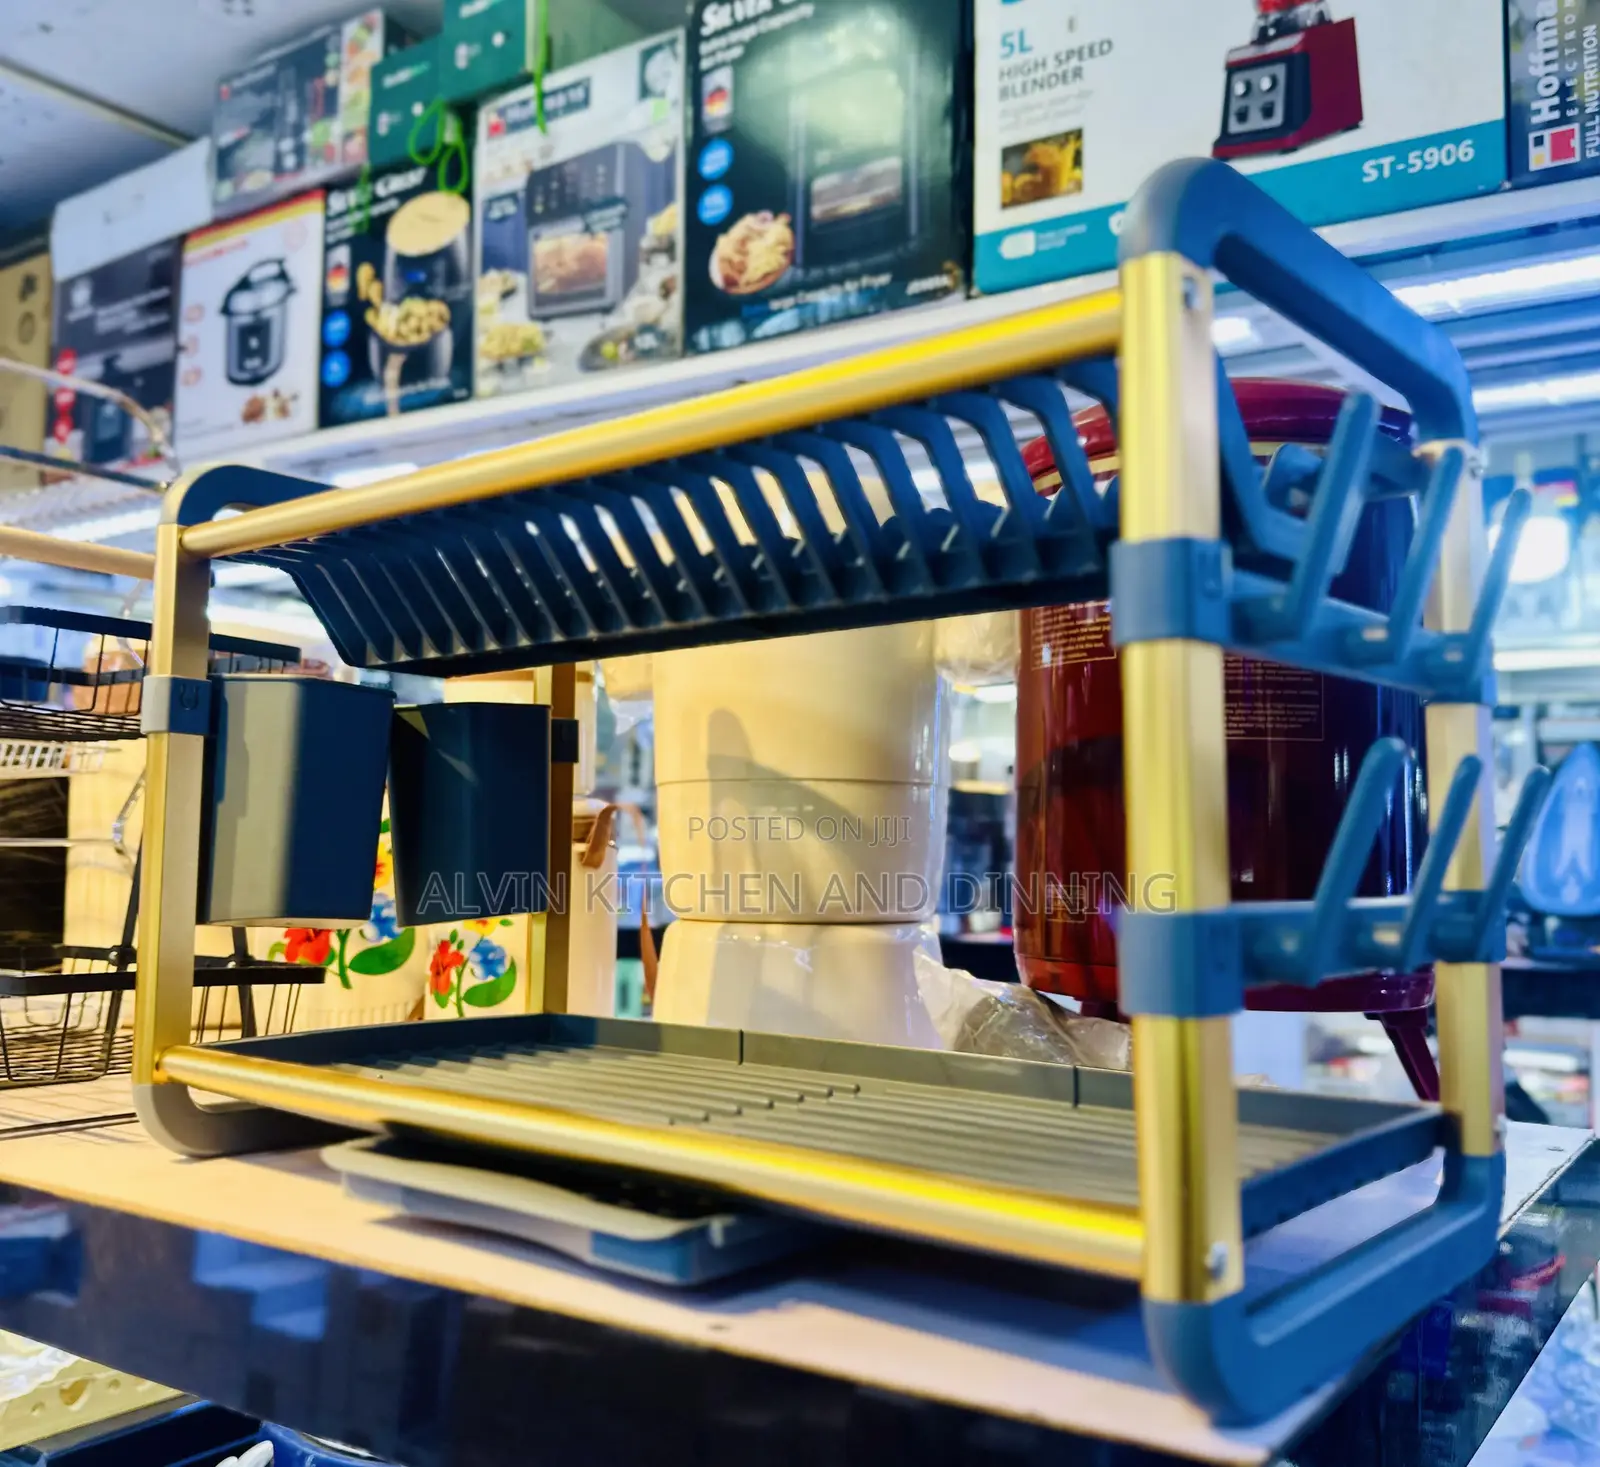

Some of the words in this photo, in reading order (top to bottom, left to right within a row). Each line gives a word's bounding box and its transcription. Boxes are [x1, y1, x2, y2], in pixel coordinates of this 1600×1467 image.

[999, 57, 1047, 82] HIGH
[1054, 38, 1113, 69] SPEED
[1000, 28, 1032, 60] 5L
[999, 65, 1084, 102] BLENDER
[1583, 24, 1600, 114] NUTRITION
[1585, 115, 1600, 158] FULL
[1362, 138, 1475, 183] ST-5906
